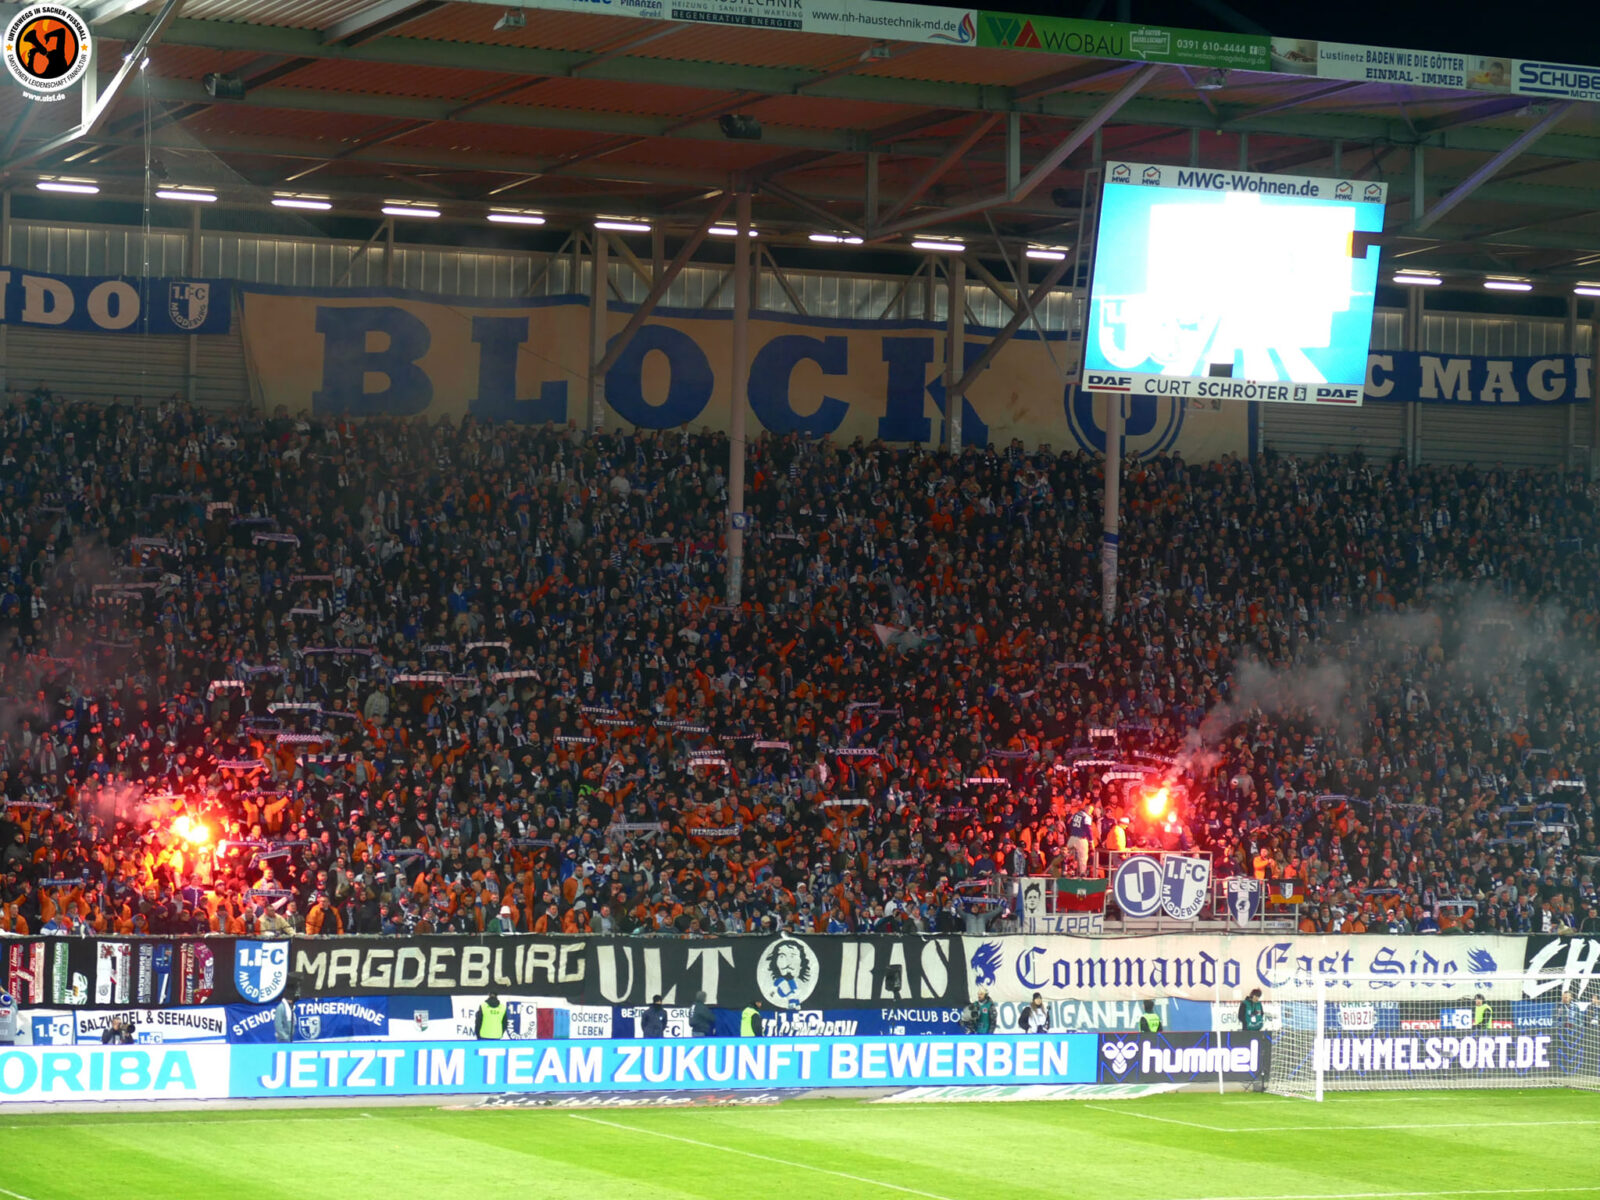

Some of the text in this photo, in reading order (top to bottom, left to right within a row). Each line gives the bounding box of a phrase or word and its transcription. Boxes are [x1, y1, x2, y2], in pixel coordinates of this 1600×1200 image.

[672, 1, 708, 10] HEIZUNG
[764, 9, 803, 18] WARTUNG
[673, 11, 801, 29] REGENERATIVE ENERGIEN
[812, 11, 957, 31] www.nh-haustechnik-md.de
[1043, 30, 1124, 57] WOBAU
[1177, 39, 1246, 54] 0391 610-4444
[1320, 50, 1464, 71] Lustinetz BADEN WIE DIE GÖTTER
[1366, 68, 1413, 82] EINMAL
[1422, 72, 1463, 86] IMMER
[1112, 176, 1130, 184] MWG
[1142, 178, 1160, 186] MWG
[1177, 170, 1319, 196] MWG-Wohnen.de
[1334, 193, 1353, 201] MWG
[1363, 195, 1382, 203] MWG
[173, 286, 206, 301] 1.FC
[312, 305, 990, 449] BLOCK
[1088, 375, 1131, 386] DAF
[1144, 378, 1288, 402] CURT SCHRÖTER
[1316, 387, 1358, 398] DAF
[1167, 860, 1206, 882] 1.FC
[1162, 884, 1204, 918] MAGDEBURG
[238, 948, 285, 967] 1.FC
[296, 942, 586, 990] MAGDEBURG
[1016, 943, 1458, 989] Commando East Side
[239, 970, 283, 999] MAGDEBURG
[146, 1010, 153, 1023] &
[158, 1011, 223, 1033] SEEHAUSEN
[232, 1010, 277, 1036] STENDA
[297, 1002, 385, 1026] TANGERMÜNDE
[461, 1008, 475, 1019] 1.F
[571, 1012, 611, 1023] OSCHERS-
[881, 1008, 964, 1023] FANCLUB BÖ
[1078, 999, 1169, 1028] ANHAT
[36, 1023, 70, 1037] 1.FC
[457, 1024, 476, 1036] FAN
[577, 1026, 603, 1036] LEBEN
[1142, 1038, 1258, 1073] hummel
[1313, 1036, 1550, 1072] HUMMELSPORT.DE
[261, 1040, 1069, 1089] JETZT IM TEAM ZUKUNFT BEWERBEN
